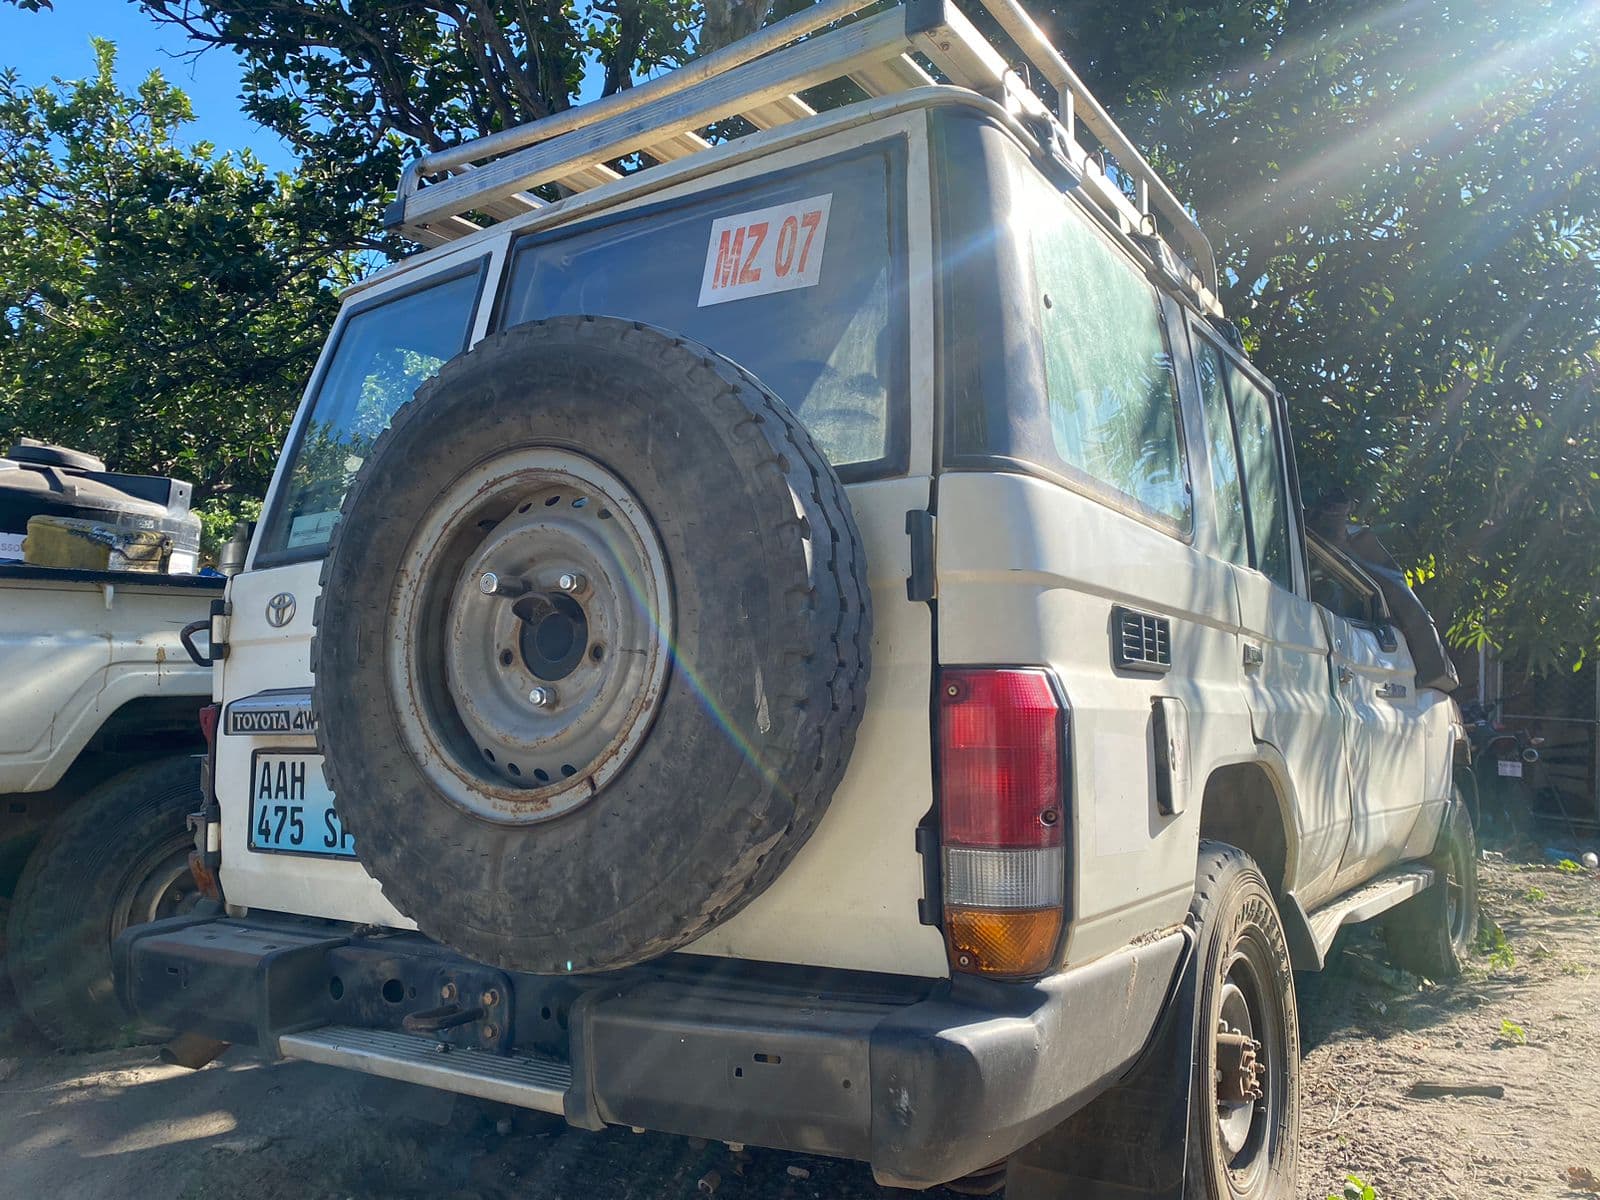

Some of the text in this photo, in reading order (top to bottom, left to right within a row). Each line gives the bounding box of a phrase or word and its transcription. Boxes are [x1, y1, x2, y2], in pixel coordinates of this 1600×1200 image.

[712, 210, 822, 290] MZ 07
[234, 711, 318, 731] TOYOTA 4W
[259, 761, 306, 800] AAH
[258, 805, 304, 845] 475
